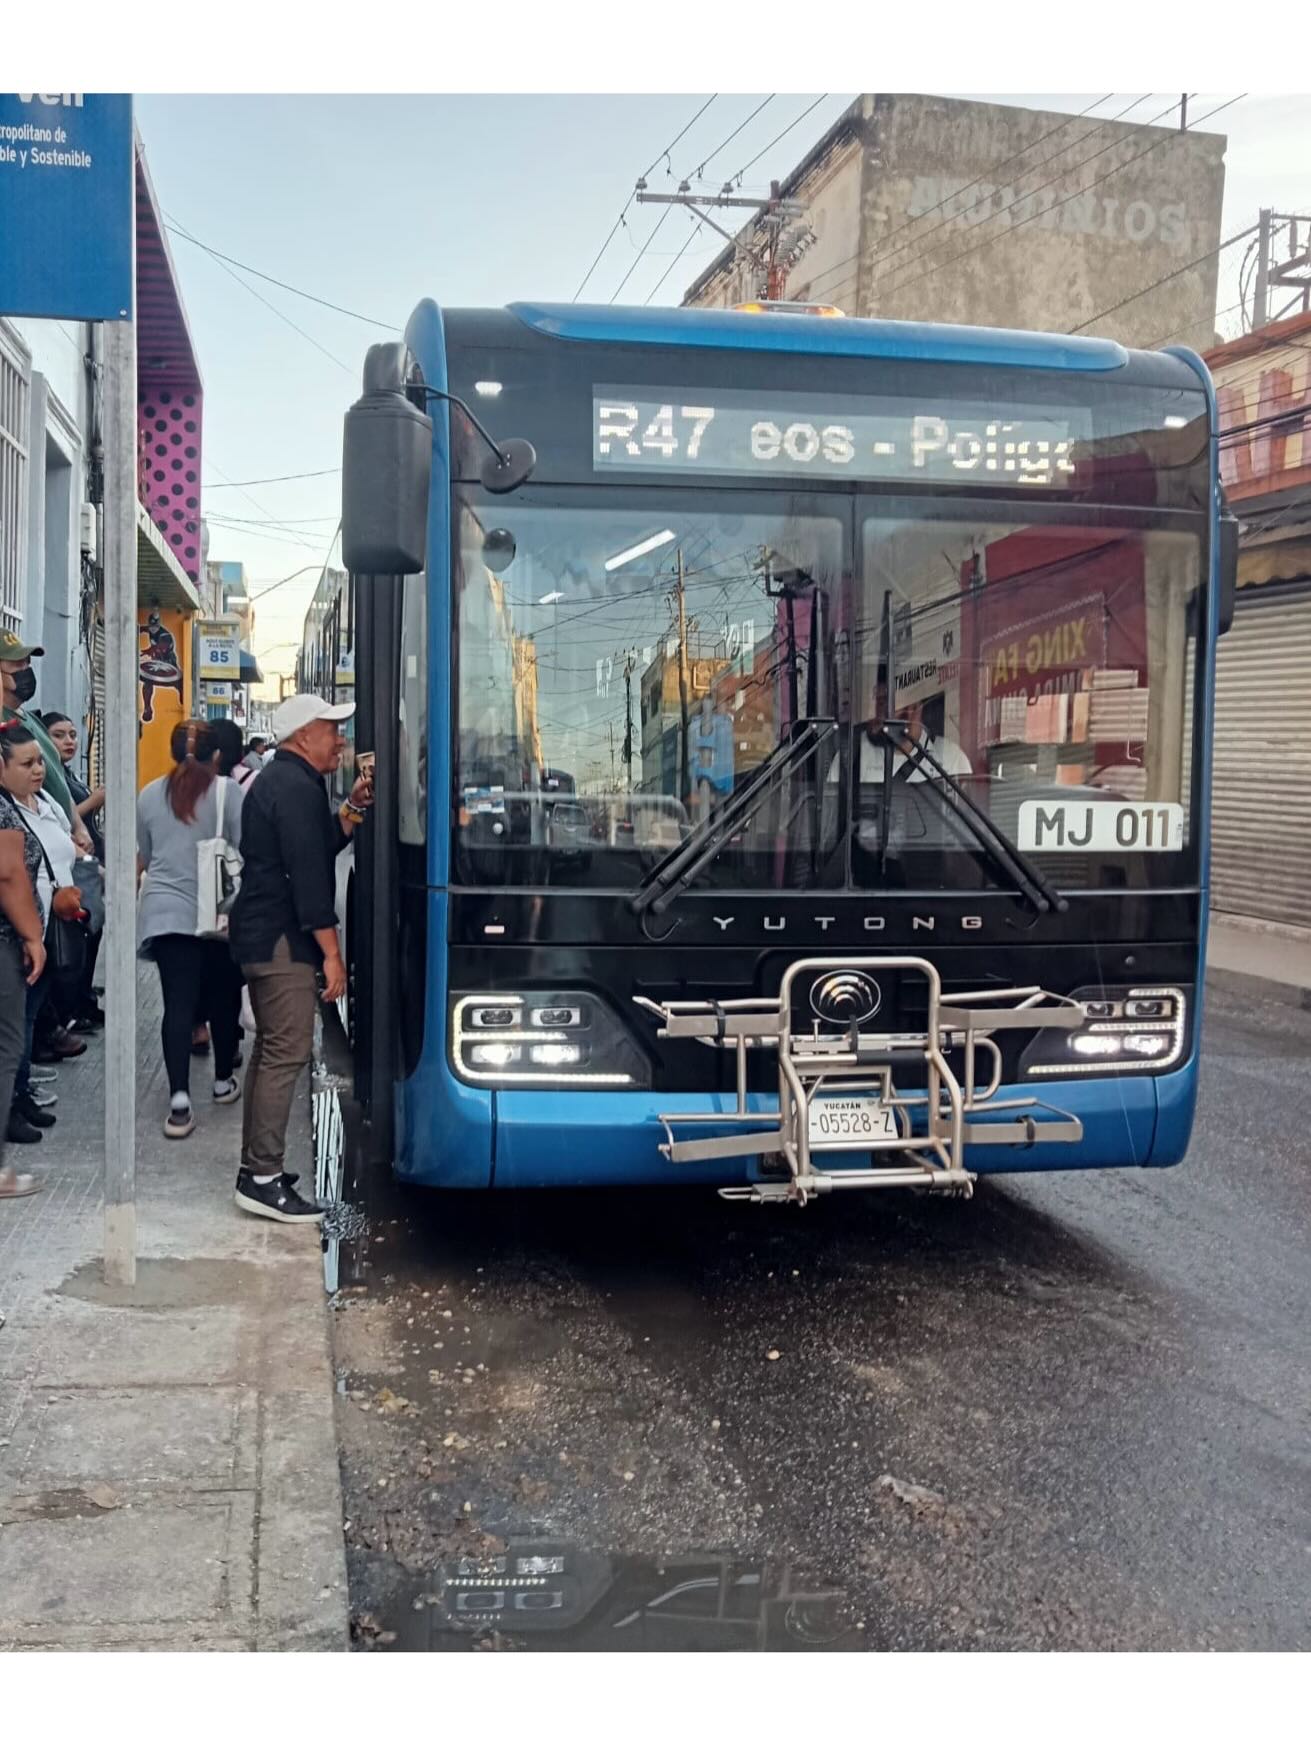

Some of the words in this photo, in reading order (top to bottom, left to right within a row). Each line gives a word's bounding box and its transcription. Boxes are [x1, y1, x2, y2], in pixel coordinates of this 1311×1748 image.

[54, 126, 67, 143] de
[20, 150, 27, 168] y
[31, 148, 92, 167] Sostenible
[599, 400, 716, 458] R47
[751, 421, 855, 463] eos
[209, 651, 229, 663] 85
[1034, 807, 1094, 847] MJ
[1115, 807, 1170, 848] 011
[713, 916, 982, 930] YUTONG
[811, 1111, 894, 1134] -05528-Z
